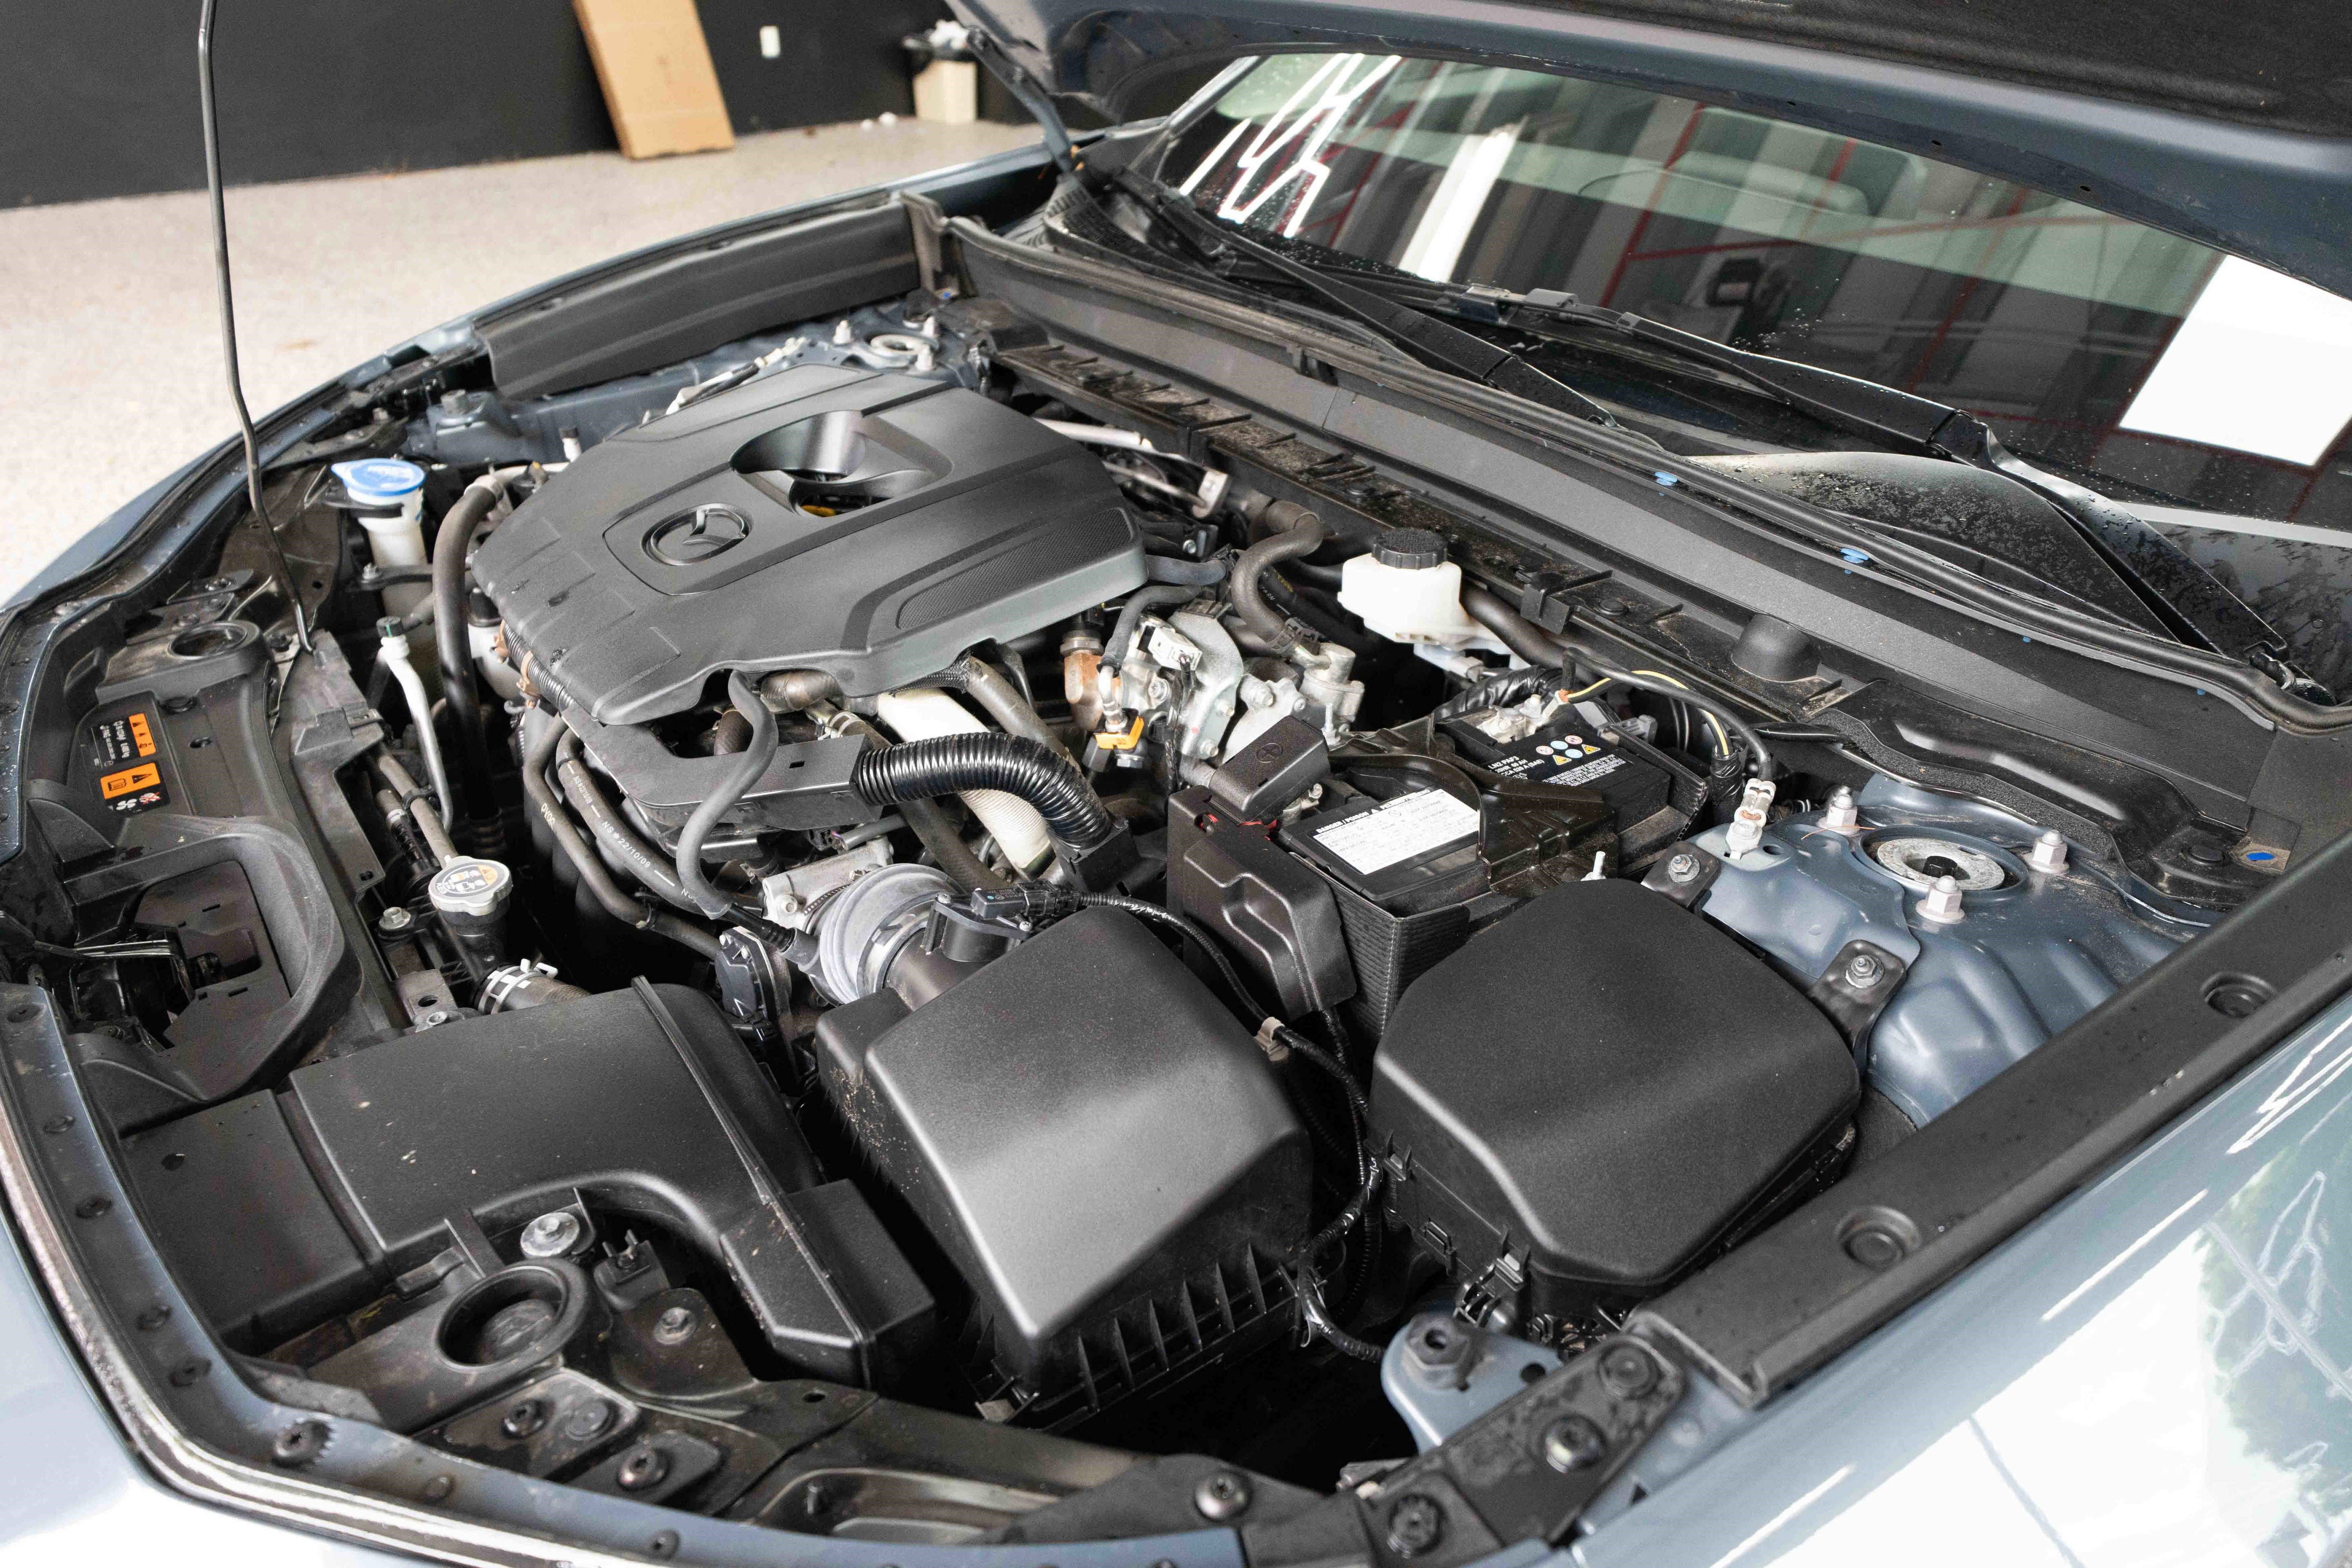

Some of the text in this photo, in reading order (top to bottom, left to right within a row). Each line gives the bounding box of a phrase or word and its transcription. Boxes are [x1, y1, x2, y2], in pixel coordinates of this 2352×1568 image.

[1501, 756, 1519, 764] PAF3
[1528, 759, 1545, 767] (SAE)
[1344, 811, 1370, 822] POISON
